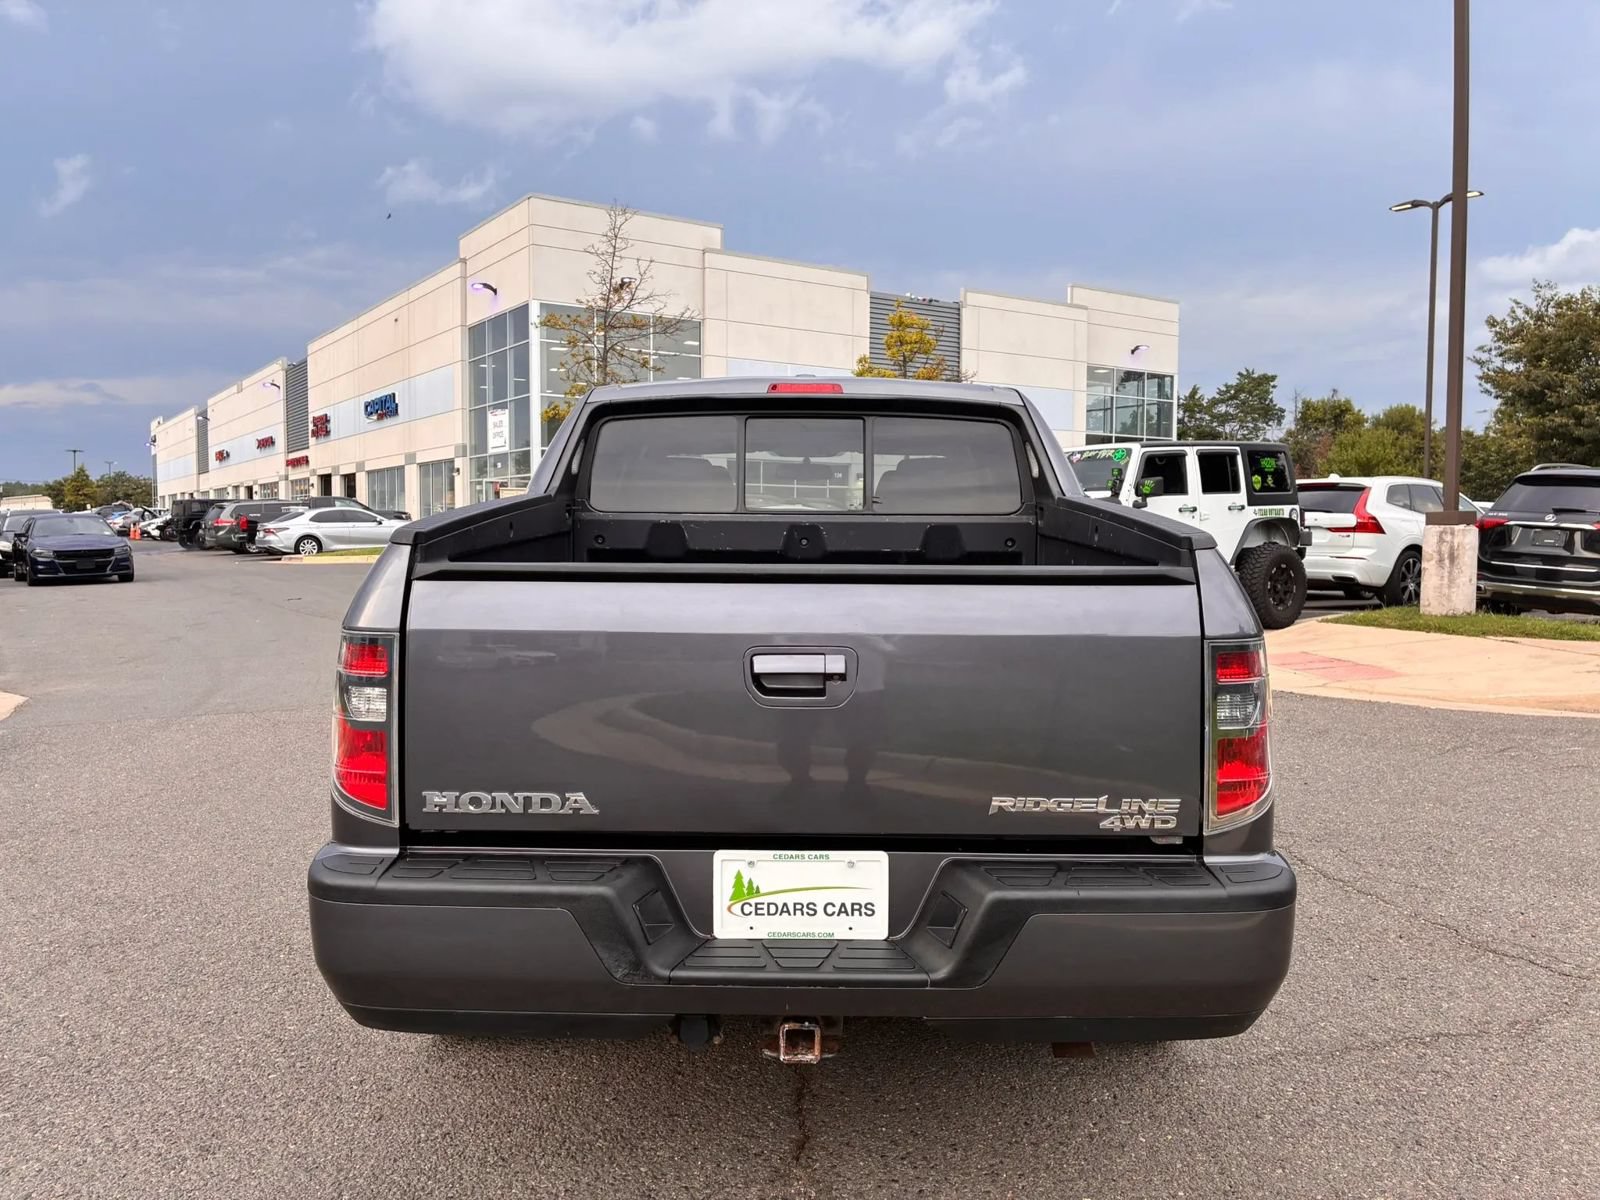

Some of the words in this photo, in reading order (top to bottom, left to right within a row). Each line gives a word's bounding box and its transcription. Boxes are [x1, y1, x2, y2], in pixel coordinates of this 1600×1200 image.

[363, 392, 397, 417] CAPITAL
[421, 791, 600, 815] HONDA
[988, 795, 1182, 816] RIDGELINE
[1099, 815, 1177, 832] 4WD
[772, 853, 806, 861] CEDARS
[807, 853, 830, 861] CARS
[740, 901, 818, 917] CEDARS
[822, 902, 876, 917] CARS
